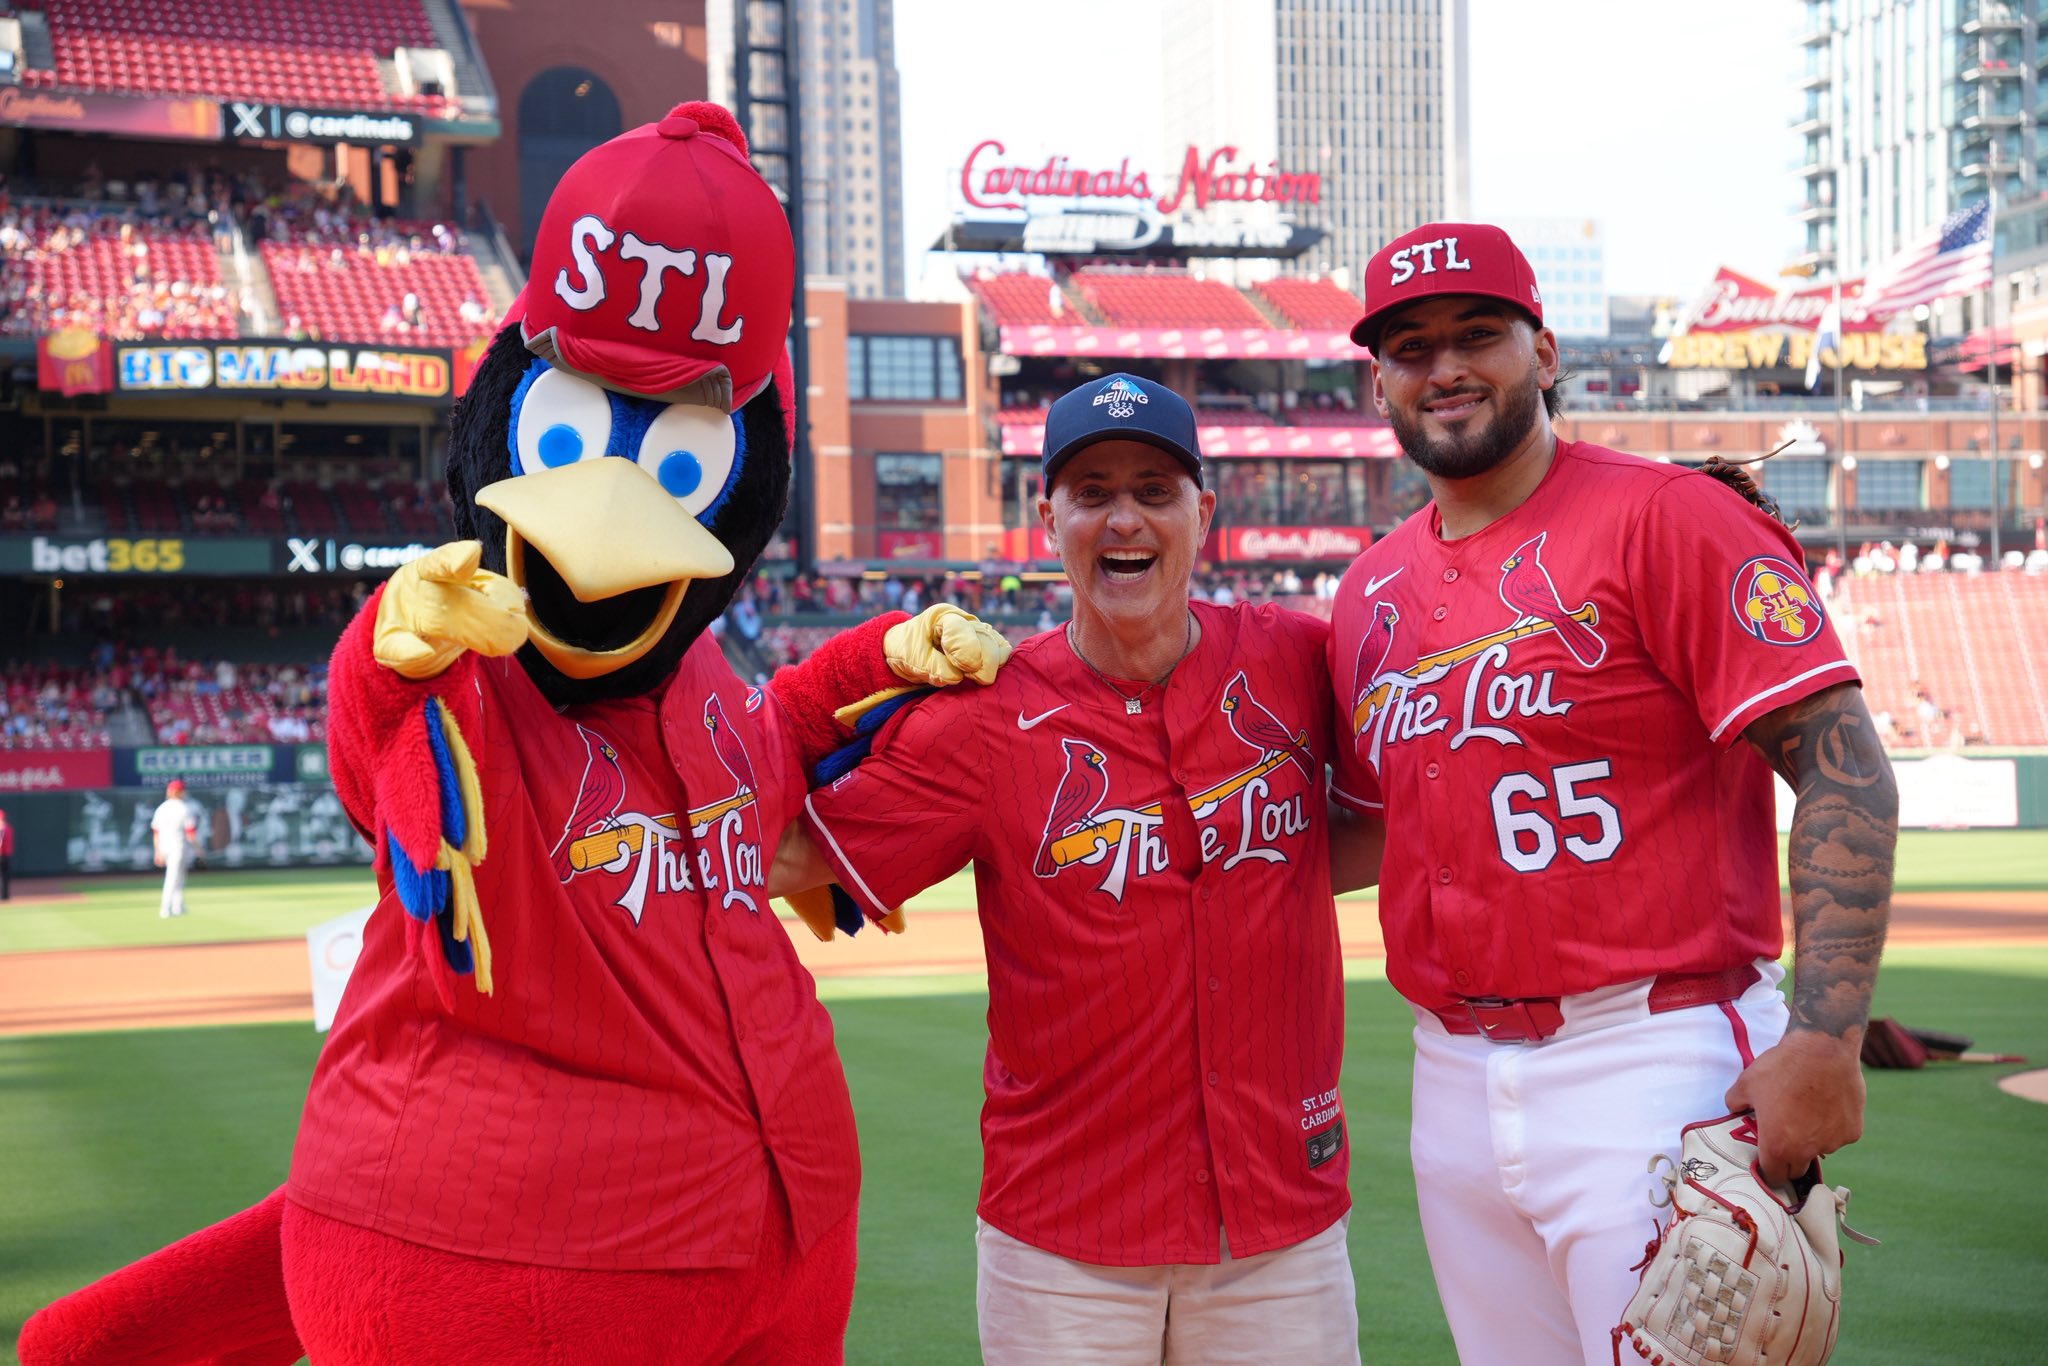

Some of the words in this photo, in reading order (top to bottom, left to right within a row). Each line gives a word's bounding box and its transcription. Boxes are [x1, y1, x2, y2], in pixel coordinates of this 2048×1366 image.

[286, 113, 413, 141] @cardinals
[961, 140, 1153, 210] Cardinals
[1157, 144, 1321, 214] Nation
[554, 213, 745, 346] STL
[1389, 237, 1471, 287] STL
[1670, 332, 1783, 370] BREW
[119, 347, 212, 390] BIG
[216, 347, 327, 389] MAC
[329, 348, 449, 397] LAND
[1092, 389, 1149, 407] BEIJING
[1108, 401, 1133, 410] 2022
[31, 537, 185, 572] bet365
[1759, 589, 1802, 614] STL
[1360, 659, 1452, 777] The
[1450, 642, 1574, 750] Lou
[142, 749, 264, 768] ROTTLER
[1223, 777, 1311, 873] Lou
[1490, 758, 1624, 873] 65
[1301, 1103, 1341, 1131] CARDINA
[1302, 1096, 1319, 1112] ST.
[1318, 1087, 1338, 1106] LOU
